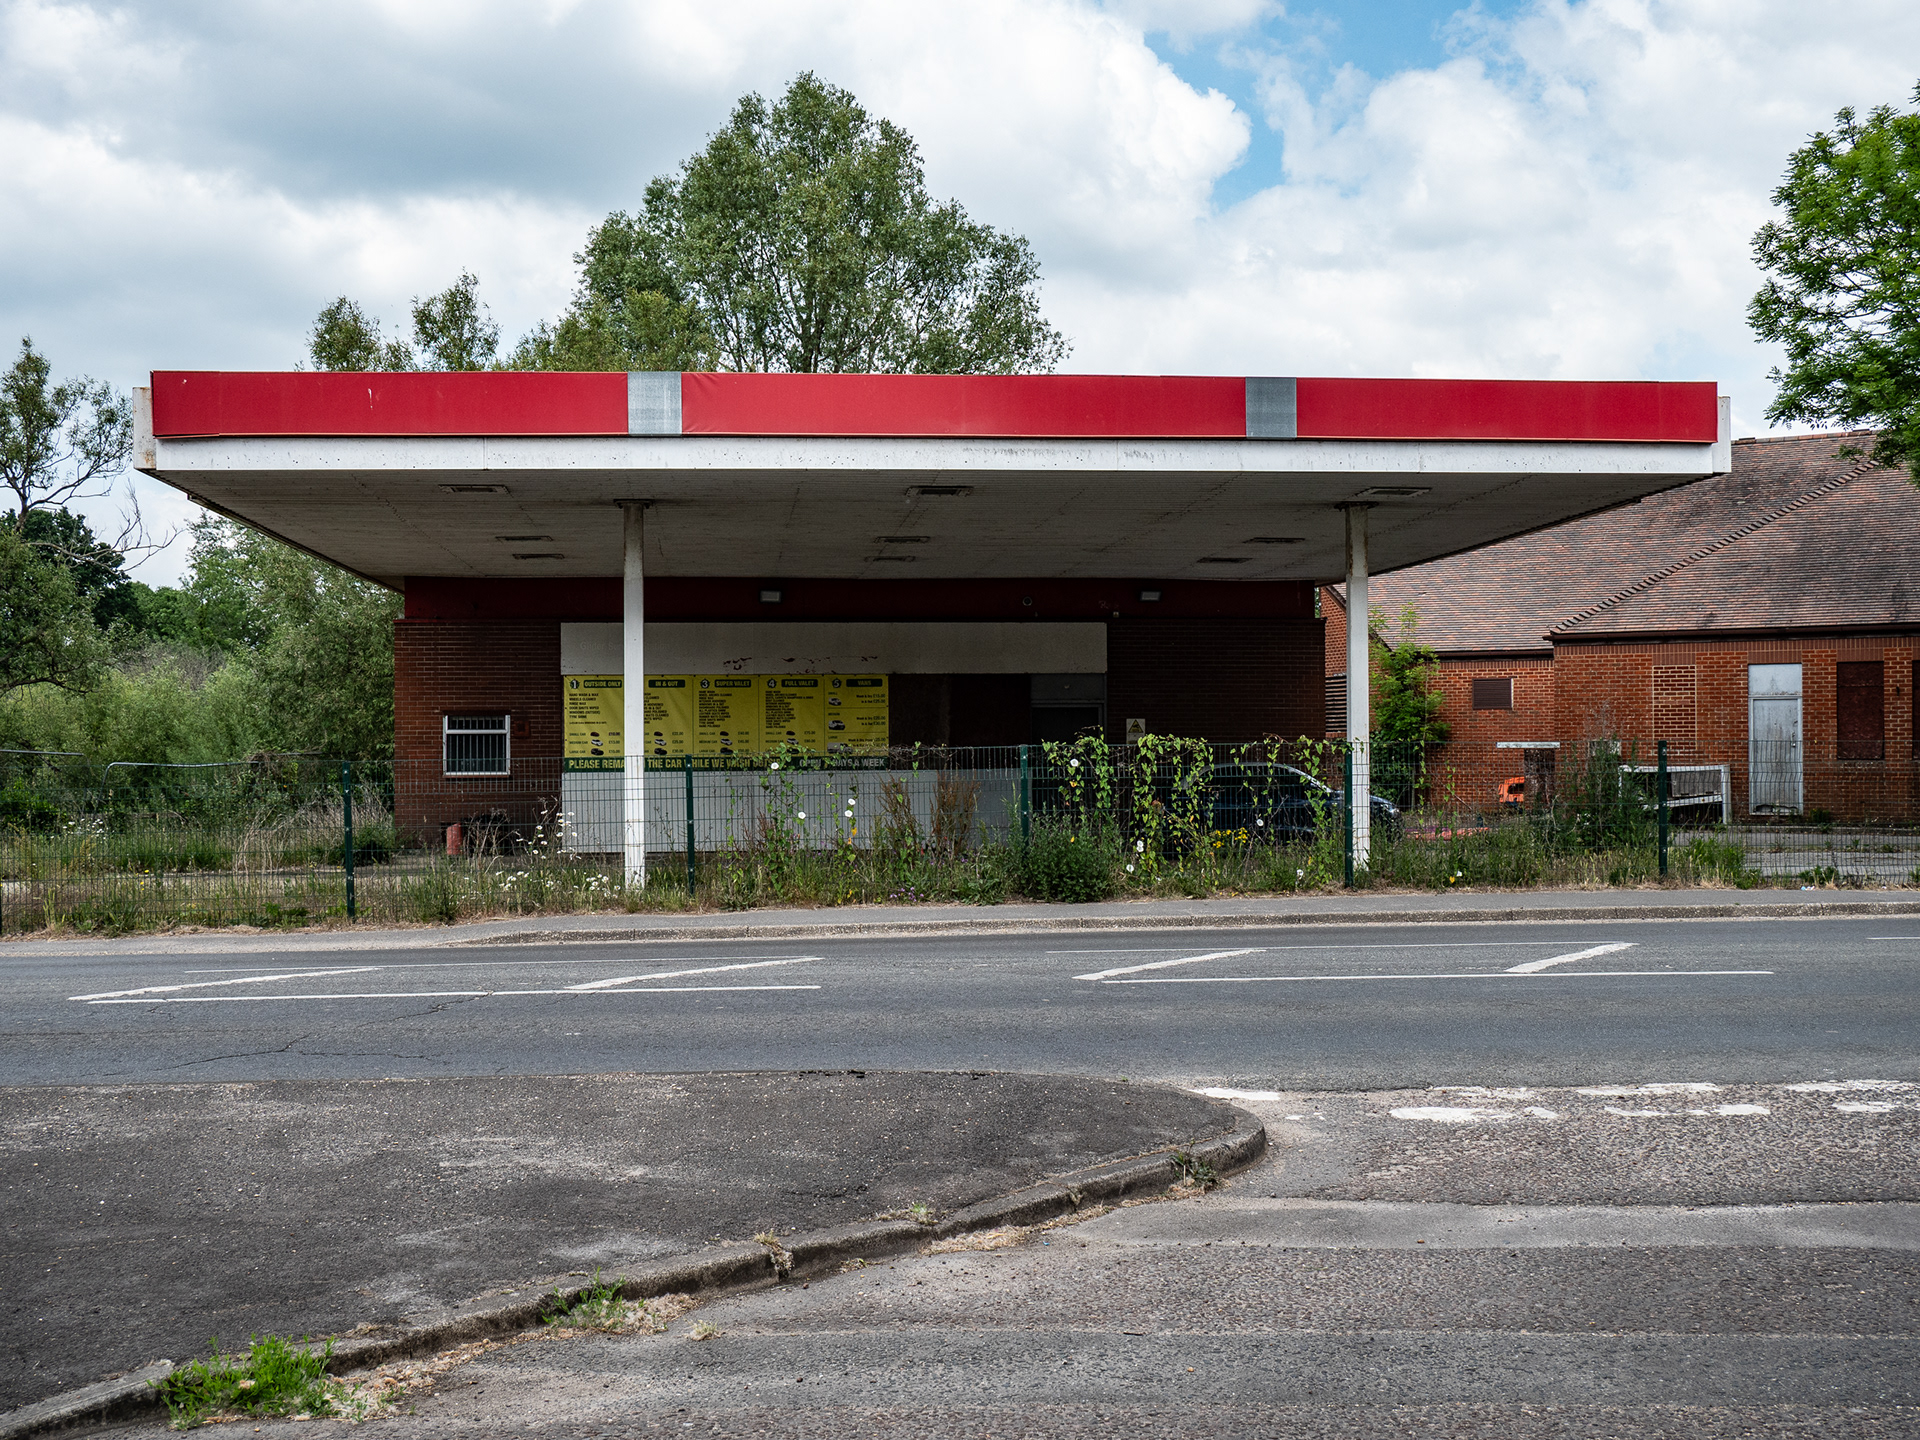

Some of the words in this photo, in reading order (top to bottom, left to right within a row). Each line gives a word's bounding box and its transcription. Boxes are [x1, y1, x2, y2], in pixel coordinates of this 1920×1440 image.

[572, 680, 577, 689] 1
[702, 680, 708, 688] 3
[569, 759, 600, 769] PLEASE
[602, 759, 625, 769] REMA
[647, 759, 663, 768] THE
[665, 759, 682, 768] CAR
[711, 758, 724, 768] WE
[861, 758, 885, 767] WEEK
